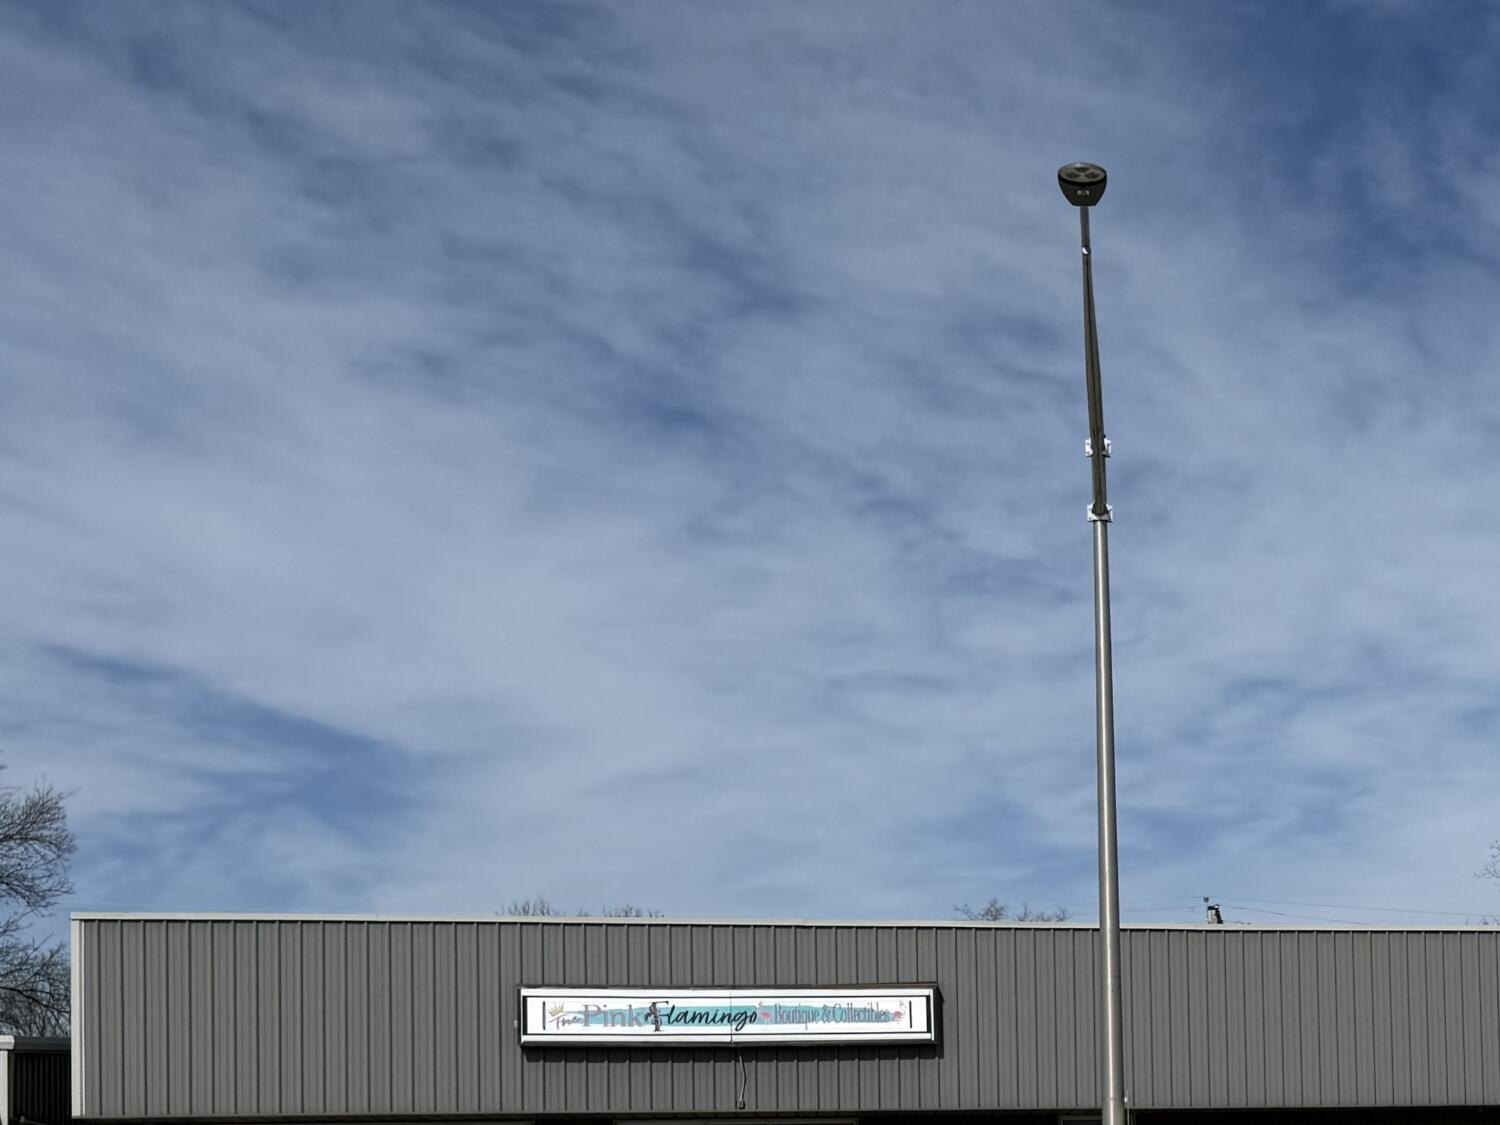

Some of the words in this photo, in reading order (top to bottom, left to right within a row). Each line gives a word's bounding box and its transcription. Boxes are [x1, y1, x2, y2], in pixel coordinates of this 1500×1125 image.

[583, 1004, 643, 1028] Pink
[646, 1001, 758, 1032] Flamingo
[774, 1003, 819, 1031] Boutique
[832, 1002, 891, 1024] Collectibles
